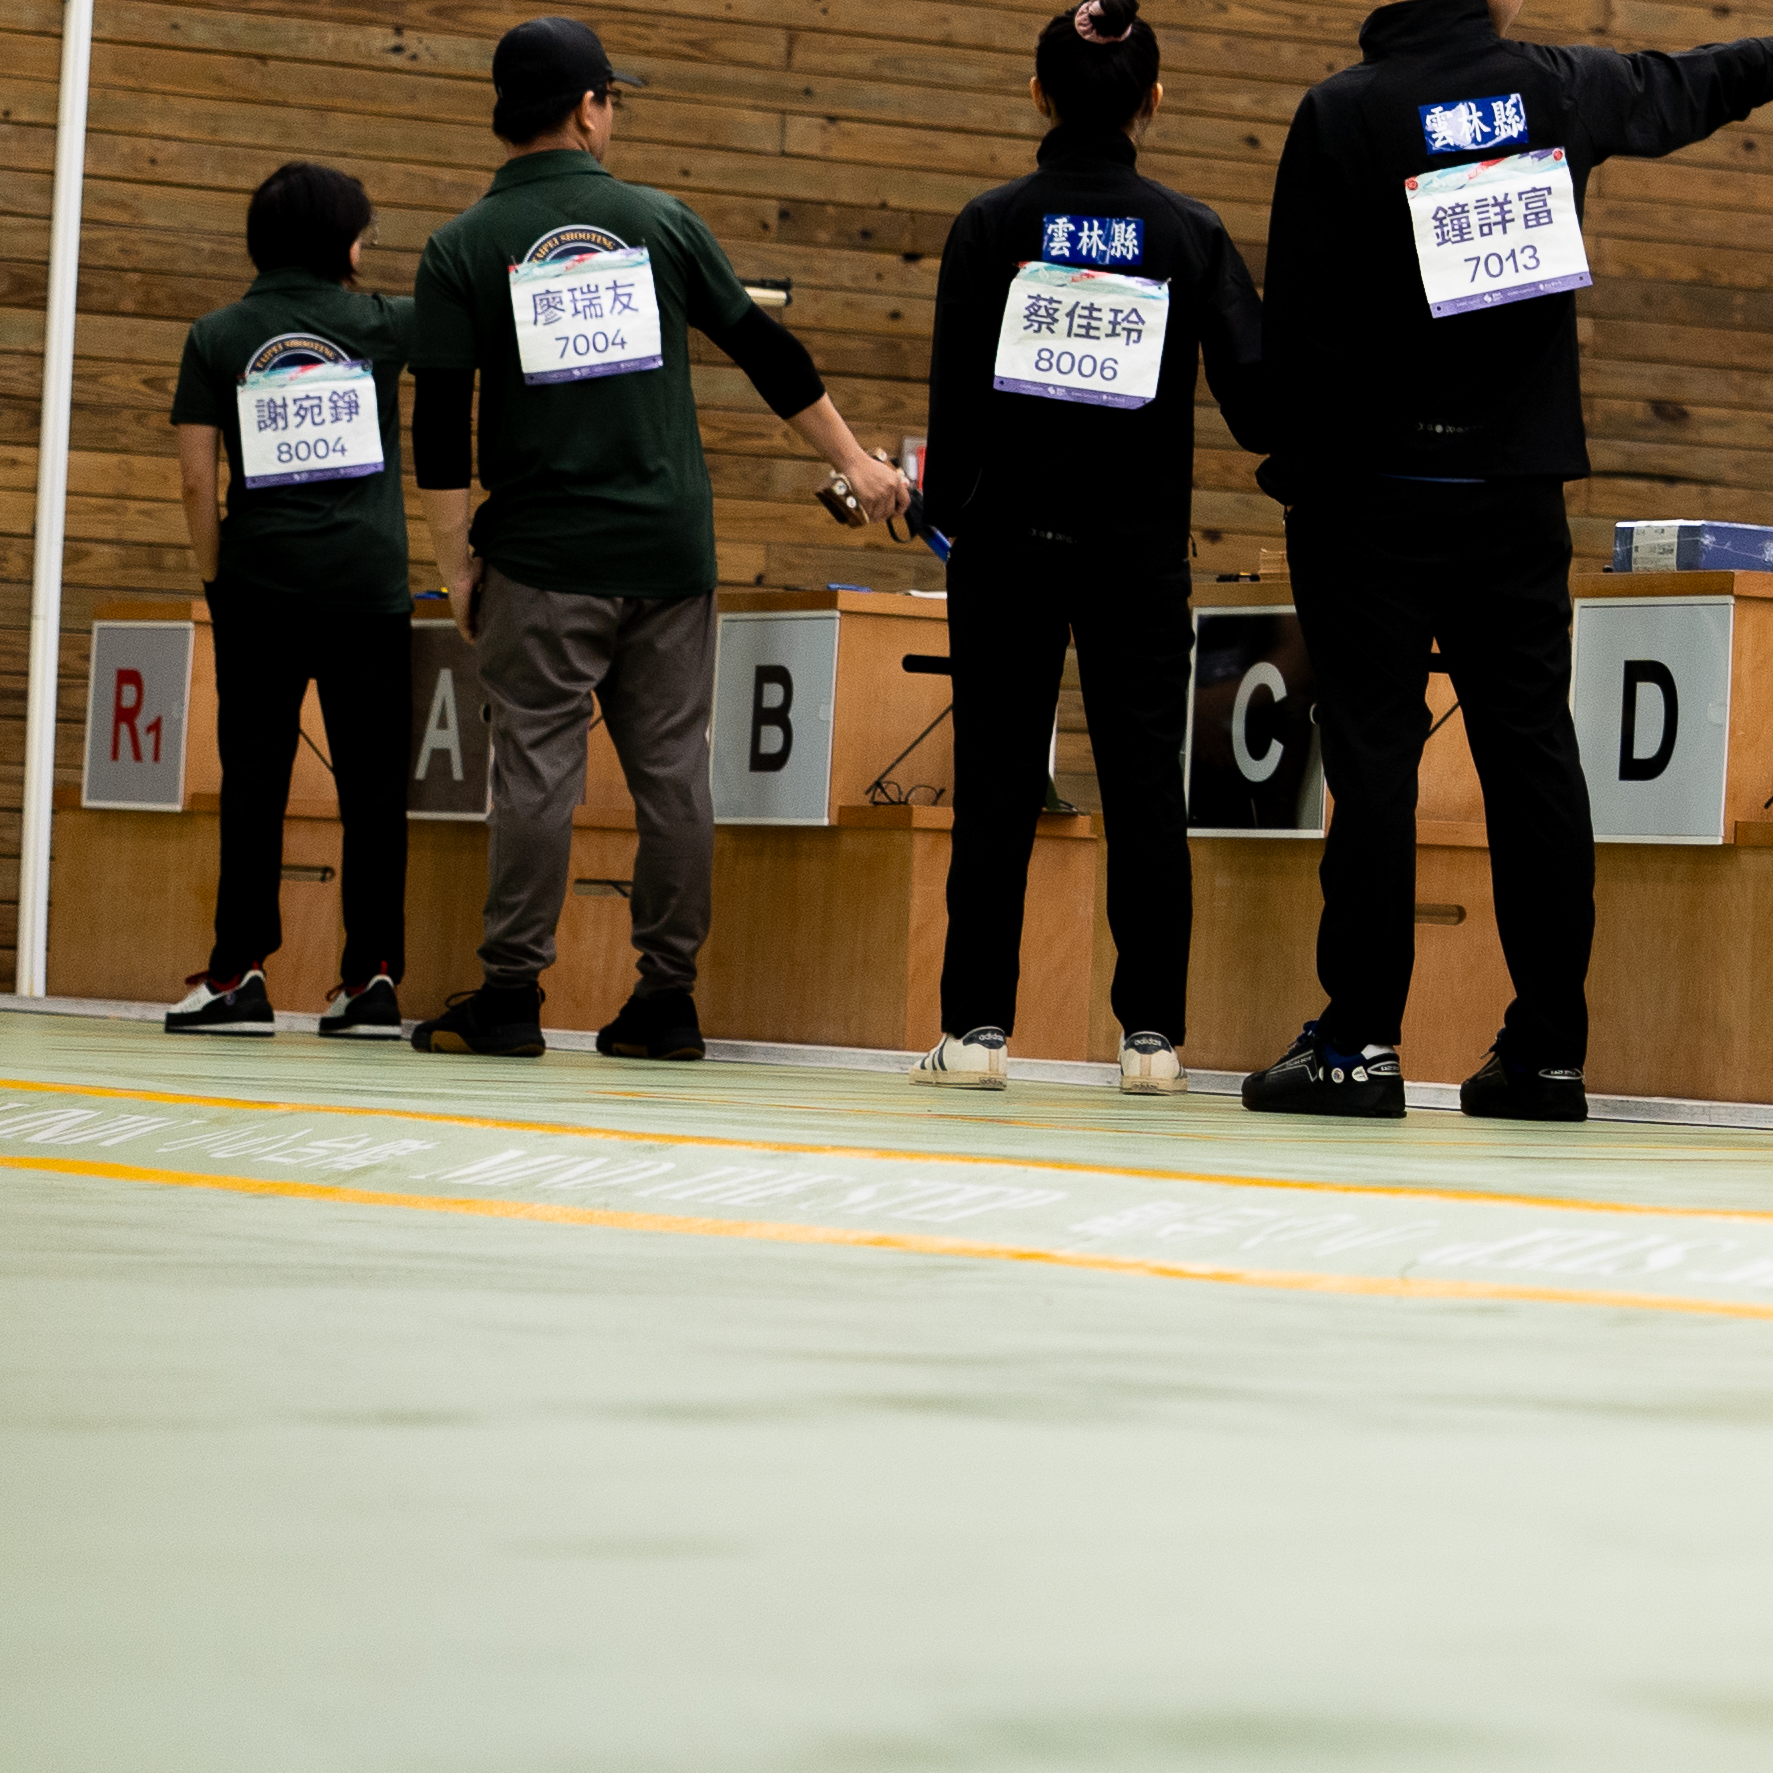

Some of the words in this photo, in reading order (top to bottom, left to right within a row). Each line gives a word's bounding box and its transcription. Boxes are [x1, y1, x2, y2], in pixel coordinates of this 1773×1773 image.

[1425, 100, 1526, 148] 雲林縣
[560, 231, 615, 250] SHOOTING
[1046, 216, 1140, 260] 雲林縣
[1431, 186, 1553, 247] 鐘詳富
[1463, 244, 1541, 283] 7013
[532, 280, 639, 326] 廖瑞友
[1023, 293, 1146, 346] 蔡佳玲
[555, 329, 627, 359] 7004
[1034, 347, 1119, 382] 8006
[255, 388, 360, 433] 謝宛錚
[277, 436, 347, 464] 8004
[112, 668, 162, 762] R1
[415, 668, 465, 781] A
[748, 663, 793, 773] B
[1232, 661, 1289, 783] C
[1619, 660, 1680, 782] D
[409, 1148, 677, 1189] MIND
[631, 1165, 860, 1208] THE
[797, 1178, 1070, 1224] STEP
